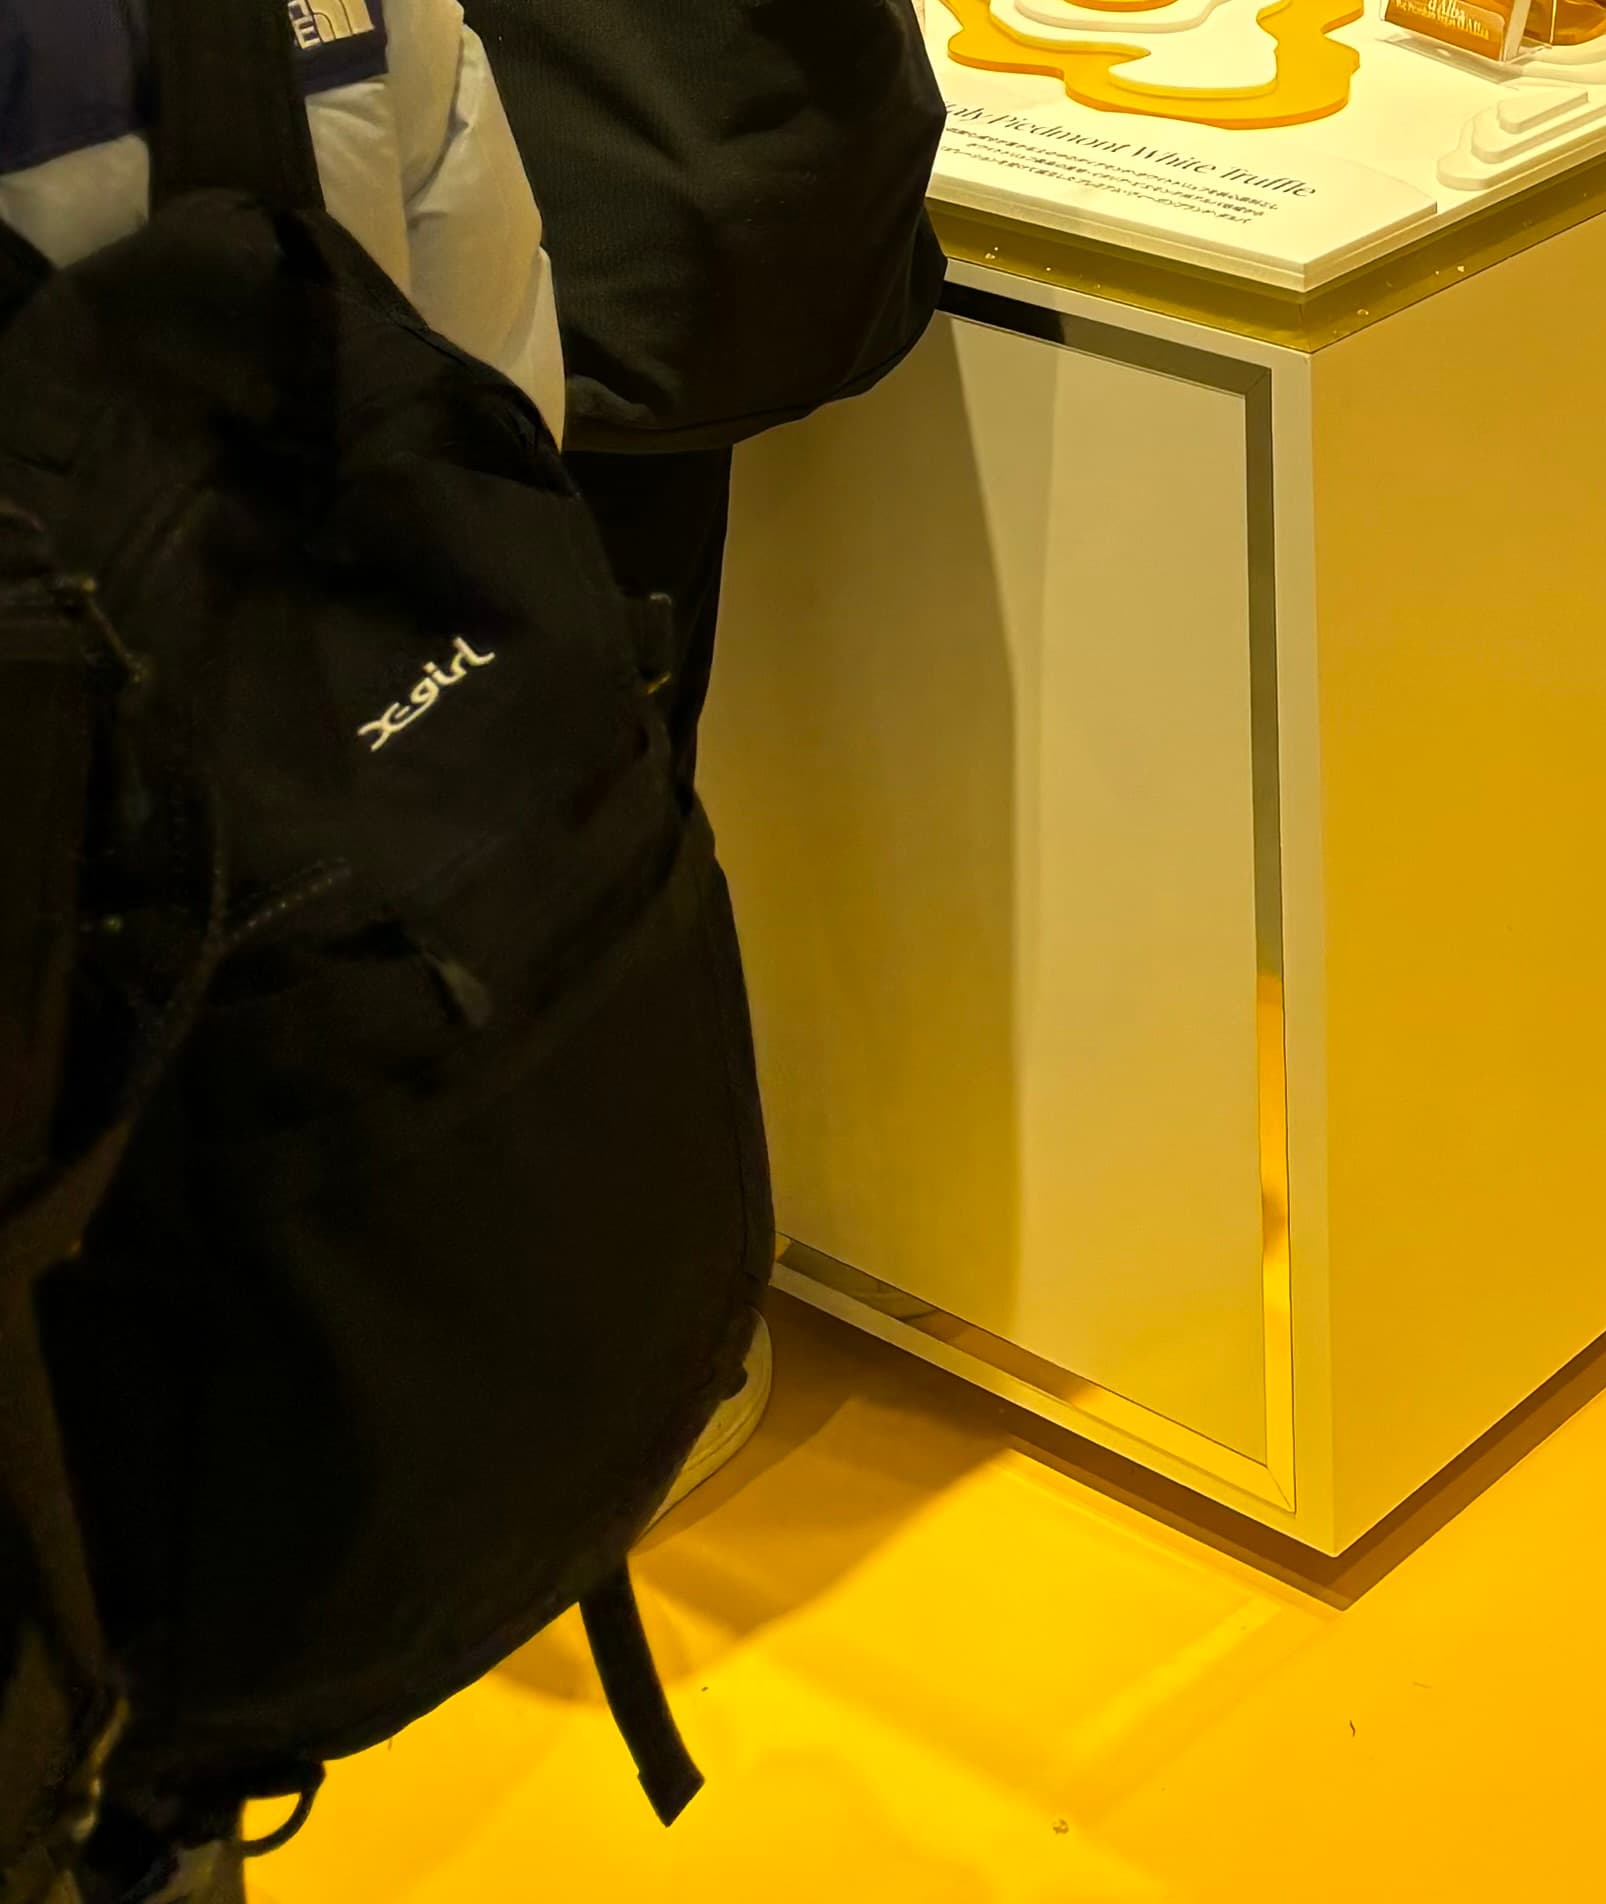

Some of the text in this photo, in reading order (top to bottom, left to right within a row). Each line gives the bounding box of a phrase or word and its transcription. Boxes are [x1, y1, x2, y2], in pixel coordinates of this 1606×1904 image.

[987, 113, 1131, 153] Piedmont
[1132, 146, 1217, 174] White
[1219, 166, 1316, 198] Truffle
[357, 636, 496, 752] X-girl
